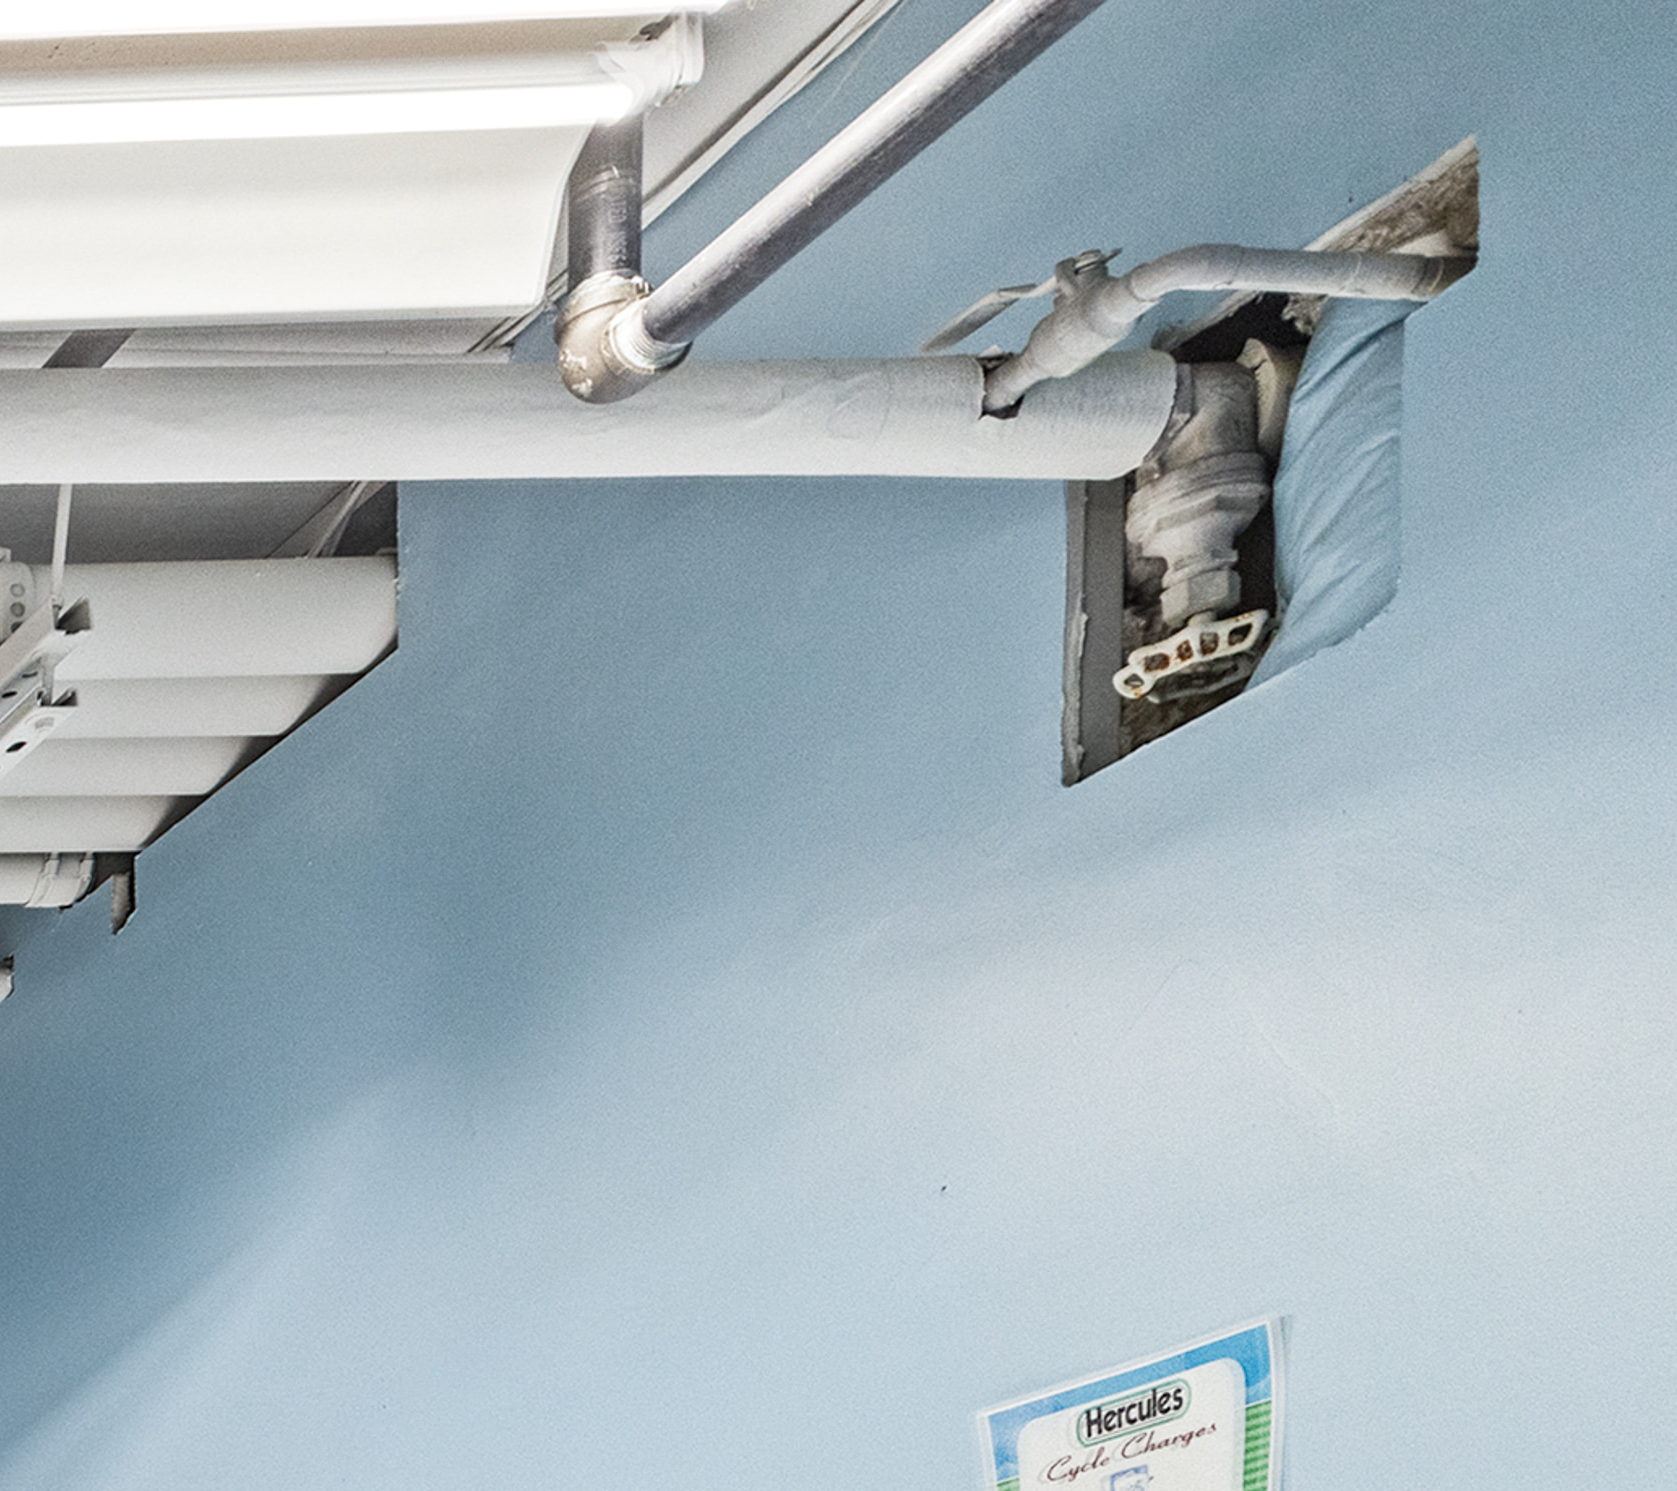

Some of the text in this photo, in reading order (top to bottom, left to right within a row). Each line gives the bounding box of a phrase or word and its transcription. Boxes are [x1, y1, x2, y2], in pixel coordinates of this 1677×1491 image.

[1084, 1385, 1183, 1438] Hercules
[1047, 1422, 1217, 1482] Cycle Charges
